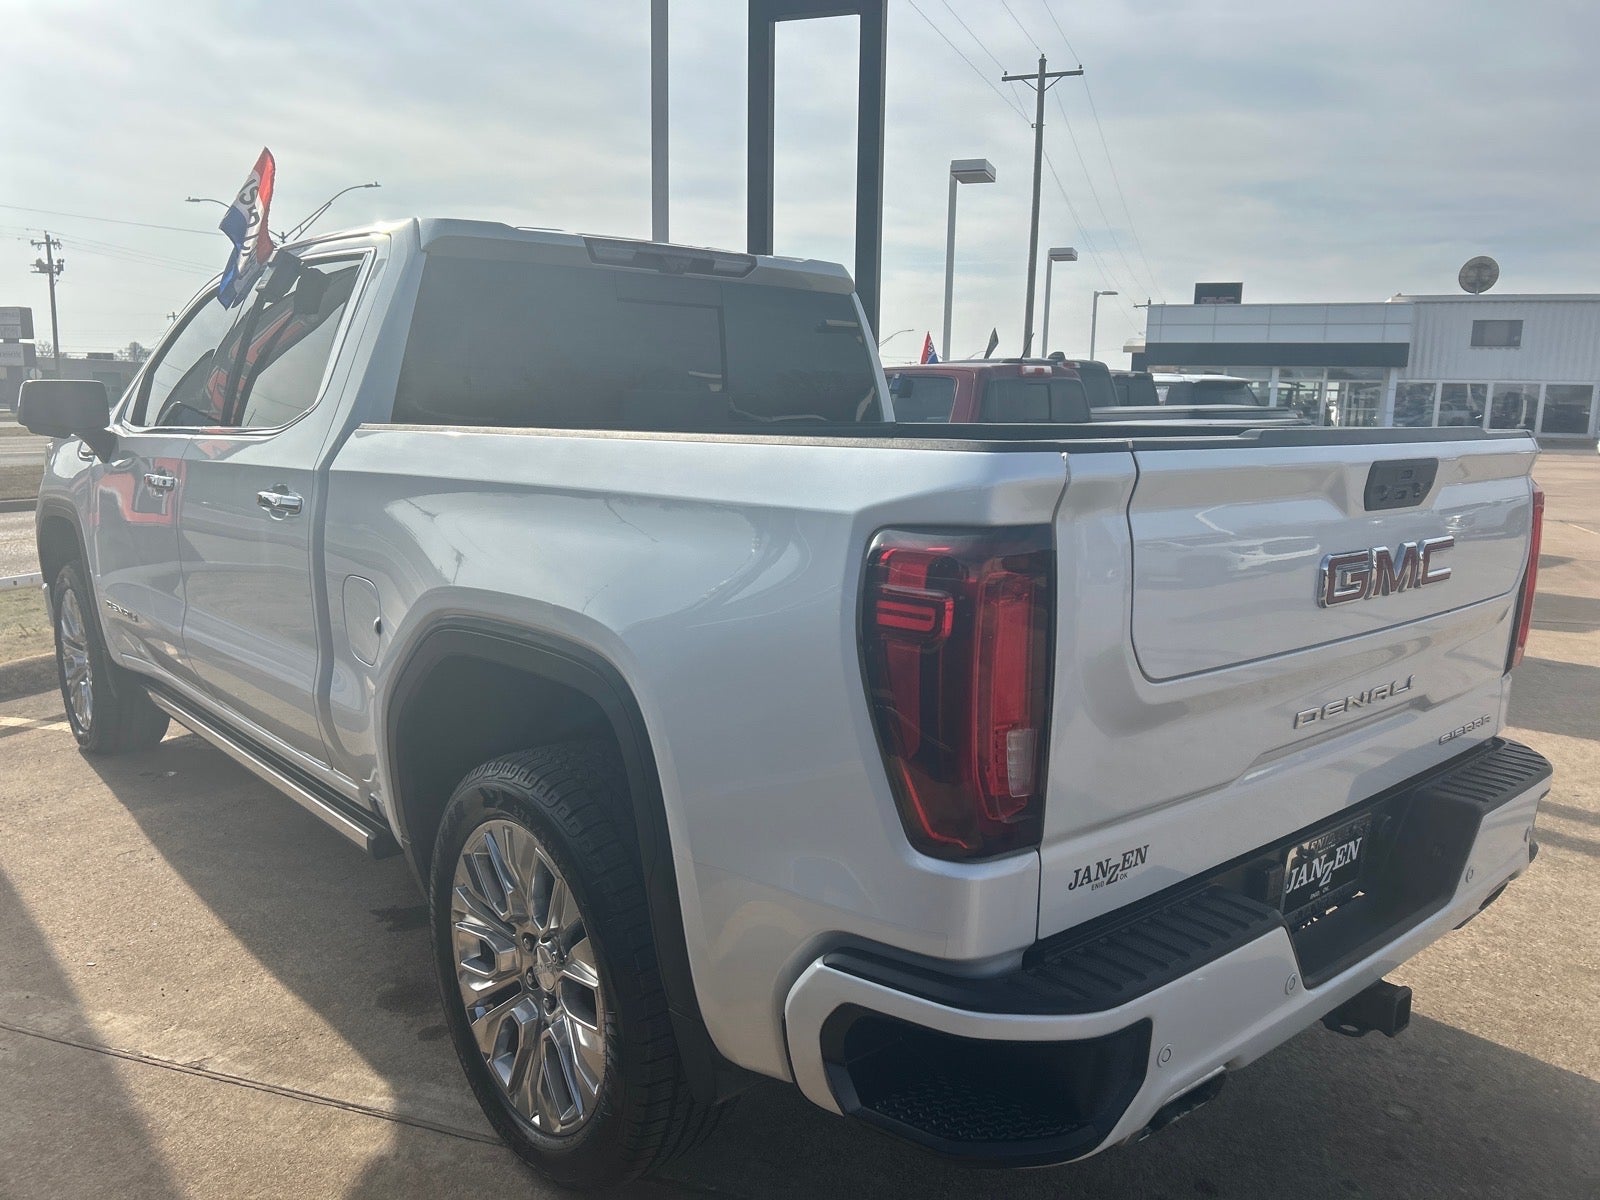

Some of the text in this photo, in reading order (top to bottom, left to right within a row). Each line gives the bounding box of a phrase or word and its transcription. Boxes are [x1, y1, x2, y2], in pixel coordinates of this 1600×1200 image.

[1317, 535, 1454, 608] GMC
[1294, 674, 1416, 730] DENALI
[1439, 713, 1490, 745] SIERRA
[1068, 844, 1150, 891] JANZEN
[1285, 837, 1363, 894] JANZEN
